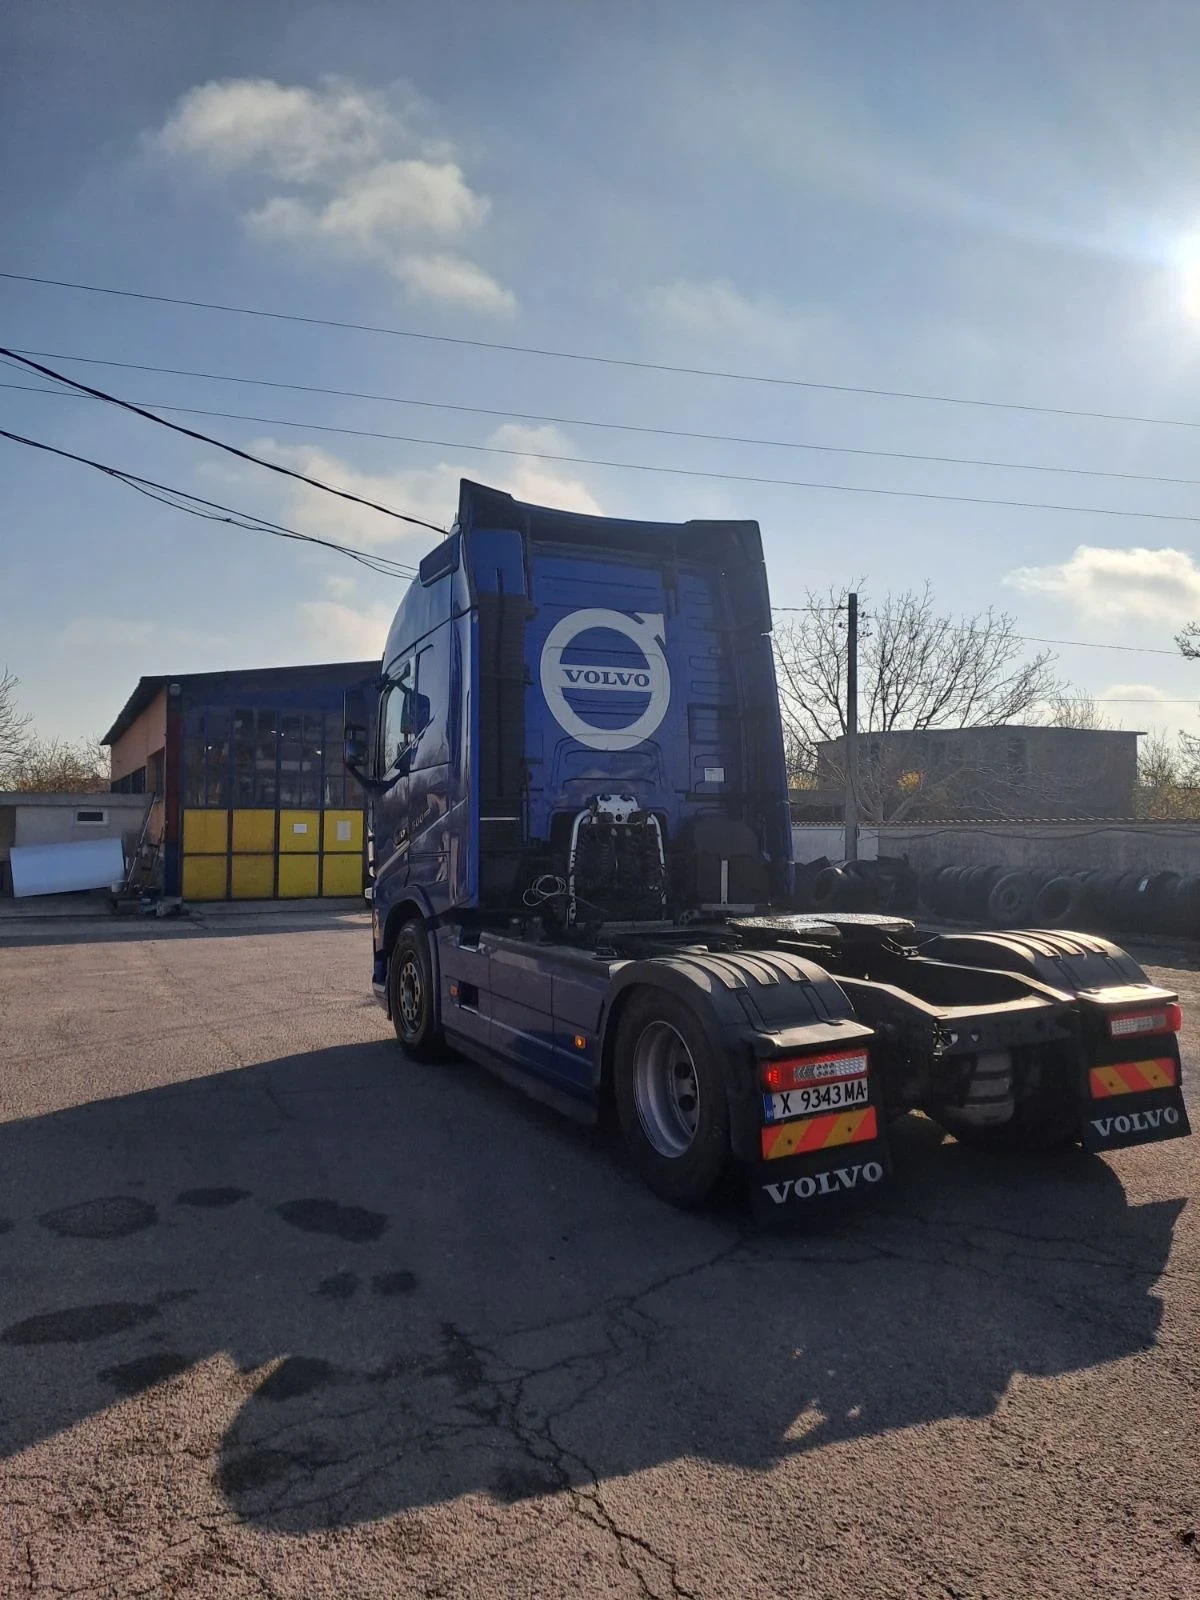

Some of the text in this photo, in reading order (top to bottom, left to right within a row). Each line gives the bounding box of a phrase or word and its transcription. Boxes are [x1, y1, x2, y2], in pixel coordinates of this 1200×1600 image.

[562, 669, 650, 687] VOLVO
[780, 1093, 791, 1115] X
[801, 1085, 841, 1110] 9343
[1090, 1107, 1179, 1137] VOLVO
[762, 1161, 884, 1204] VOLVO
